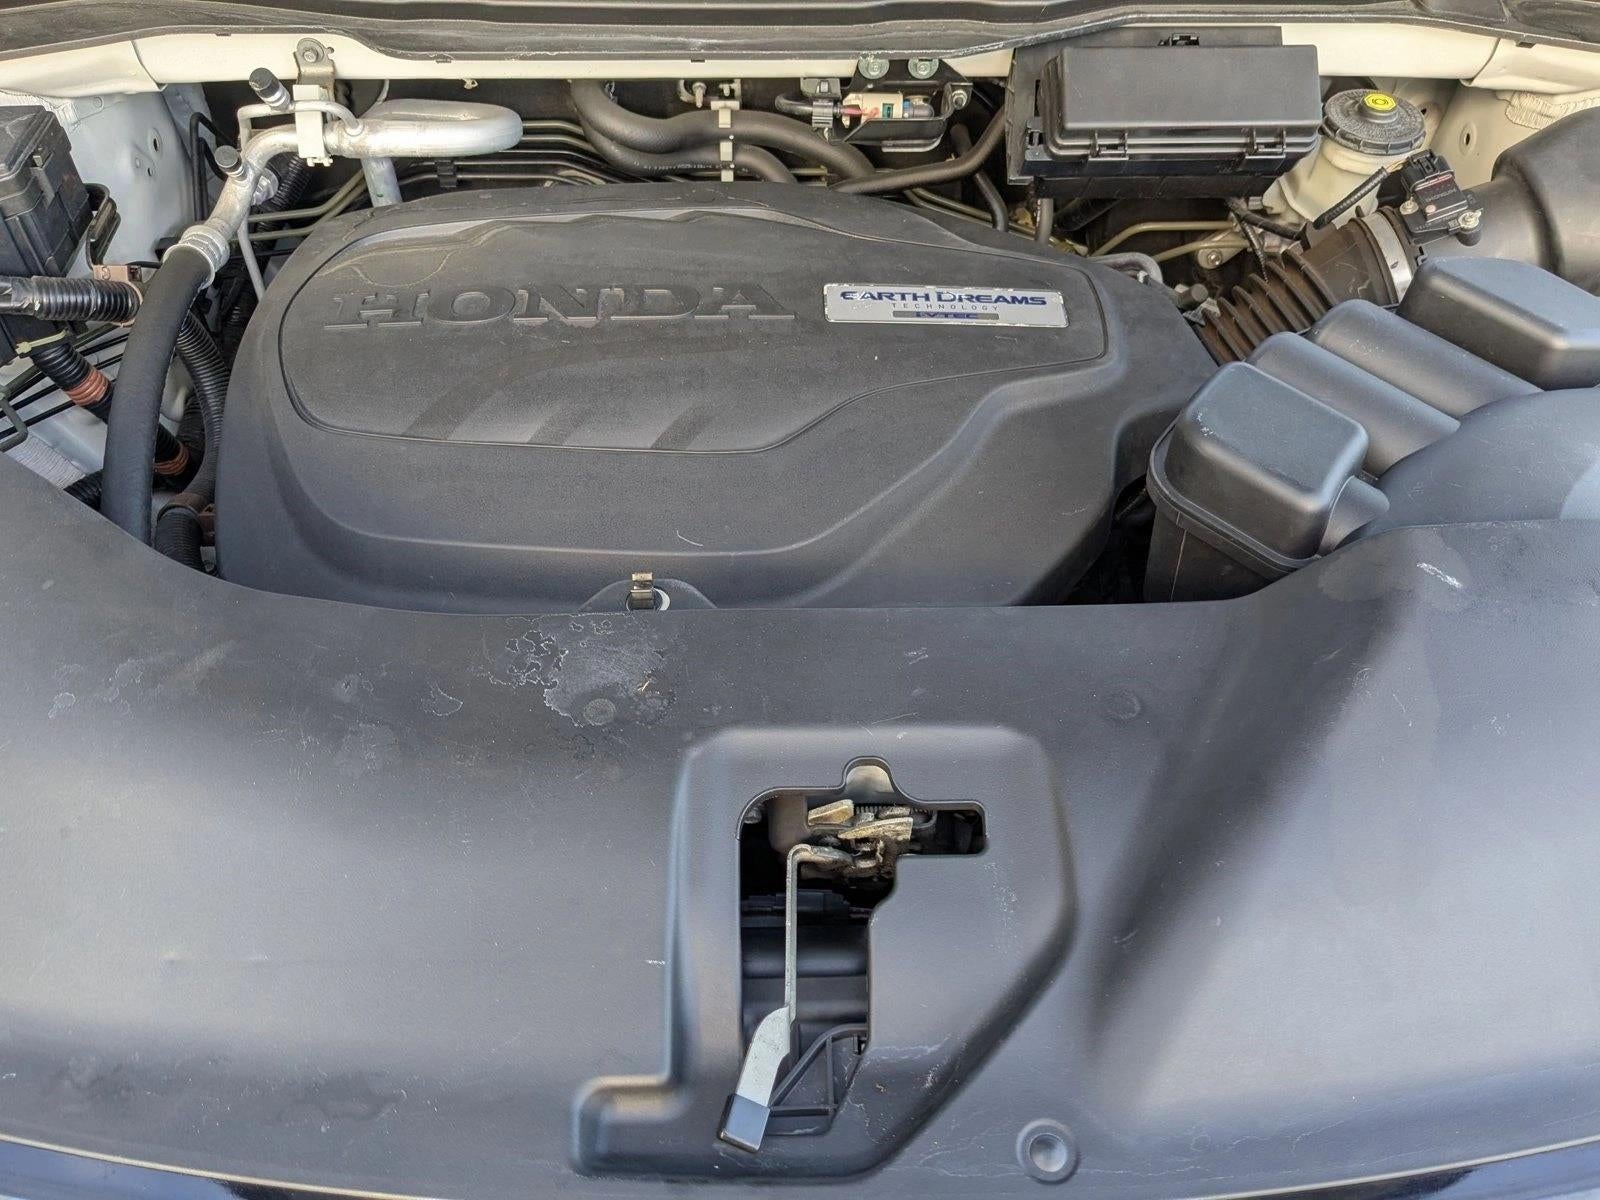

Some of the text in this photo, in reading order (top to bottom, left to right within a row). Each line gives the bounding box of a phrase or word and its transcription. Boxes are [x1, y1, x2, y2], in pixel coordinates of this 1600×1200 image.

[840, 291, 1047, 305] EARTH DREAMS
[323, 283, 796, 330] HONDA
[892, 302, 999, 311] TECHNOLOGY
